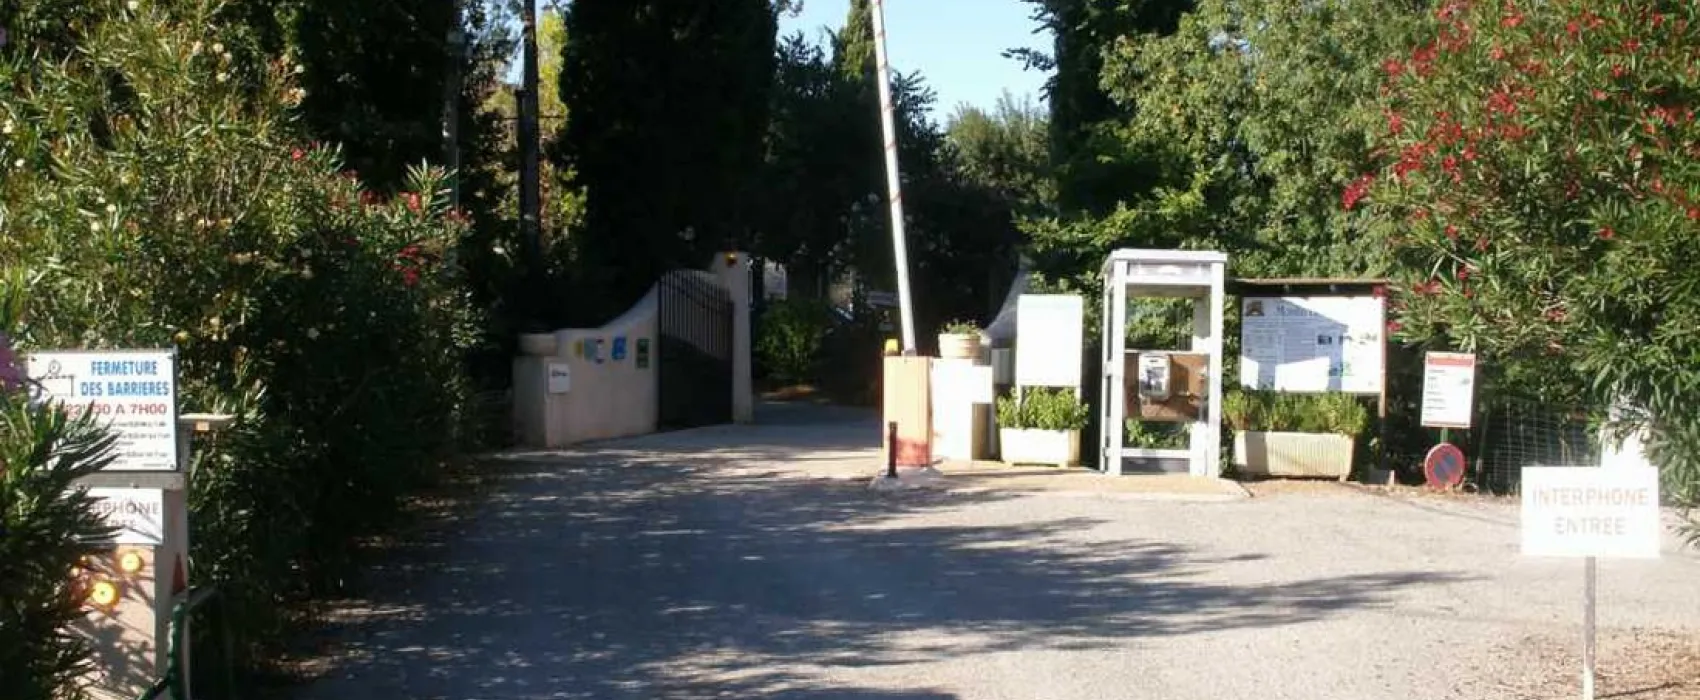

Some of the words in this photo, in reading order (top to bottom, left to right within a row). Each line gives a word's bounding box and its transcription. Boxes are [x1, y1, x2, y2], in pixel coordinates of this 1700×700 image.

[91, 361, 157, 376] FERMETURE
[80, 381, 103, 396] DES
[107, 381, 169, 396] BARRIERES
[115, 404, 125, 415] A
[130, 404, 167, 415] 7H00
[1532, 486, 1649, 506] INTERPHONE
